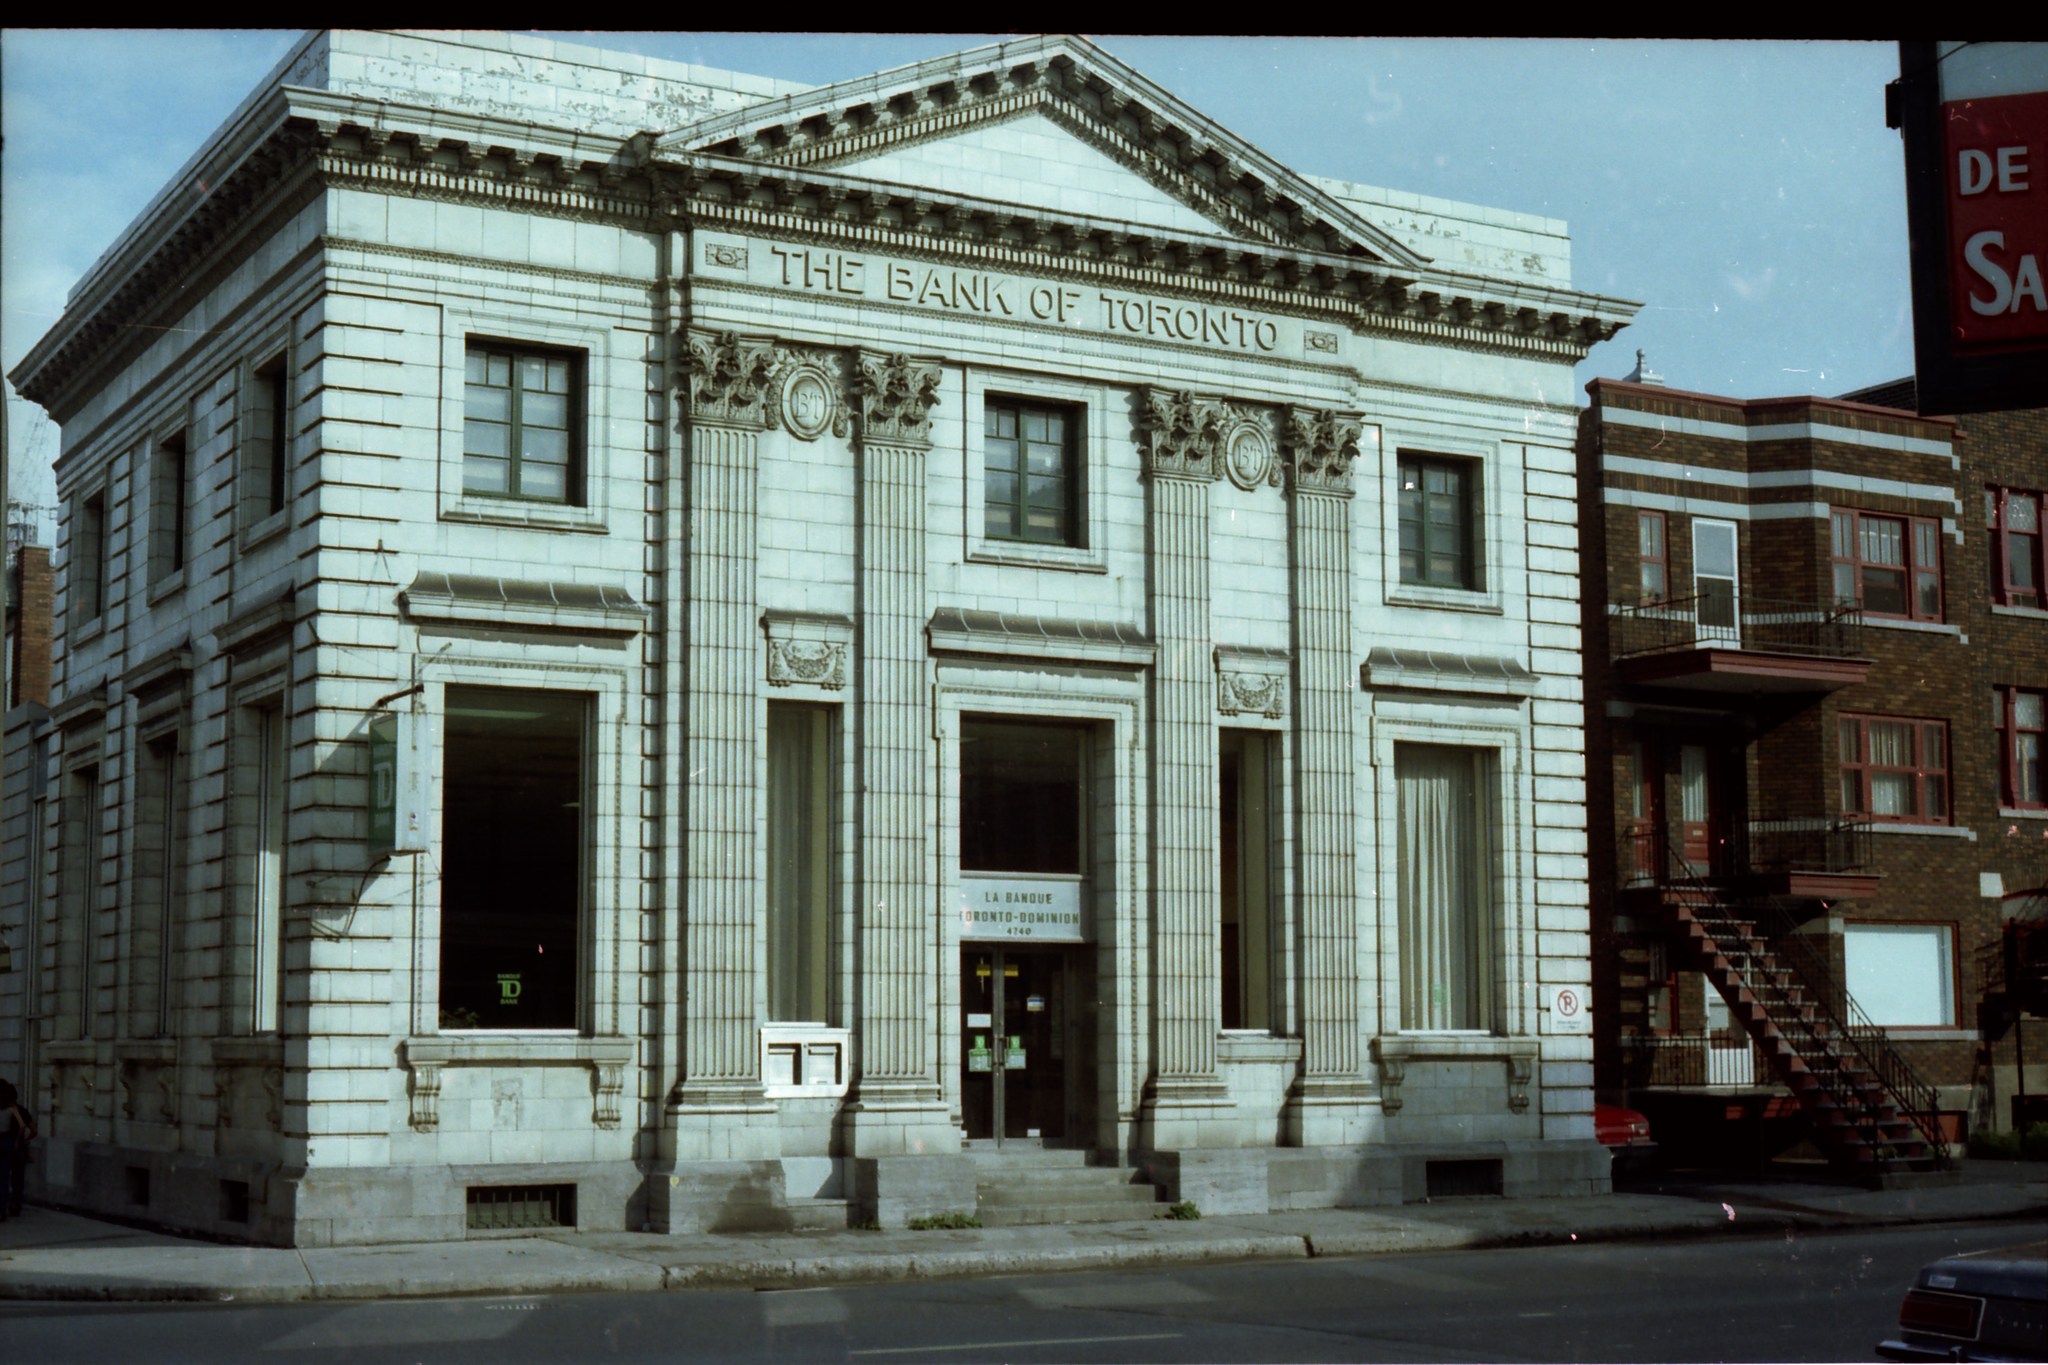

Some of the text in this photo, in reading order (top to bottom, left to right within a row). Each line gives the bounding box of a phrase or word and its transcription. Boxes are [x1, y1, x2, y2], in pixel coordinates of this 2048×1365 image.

[1959, 146, 2028, 195] DE
[771, 245, 1277, 351] THE BANK OF TORONTO
[794, 391, 823, 420] BT
[985, 892, 1053, 905] LA BANQUE
[497, 980, 522, 998] TD
